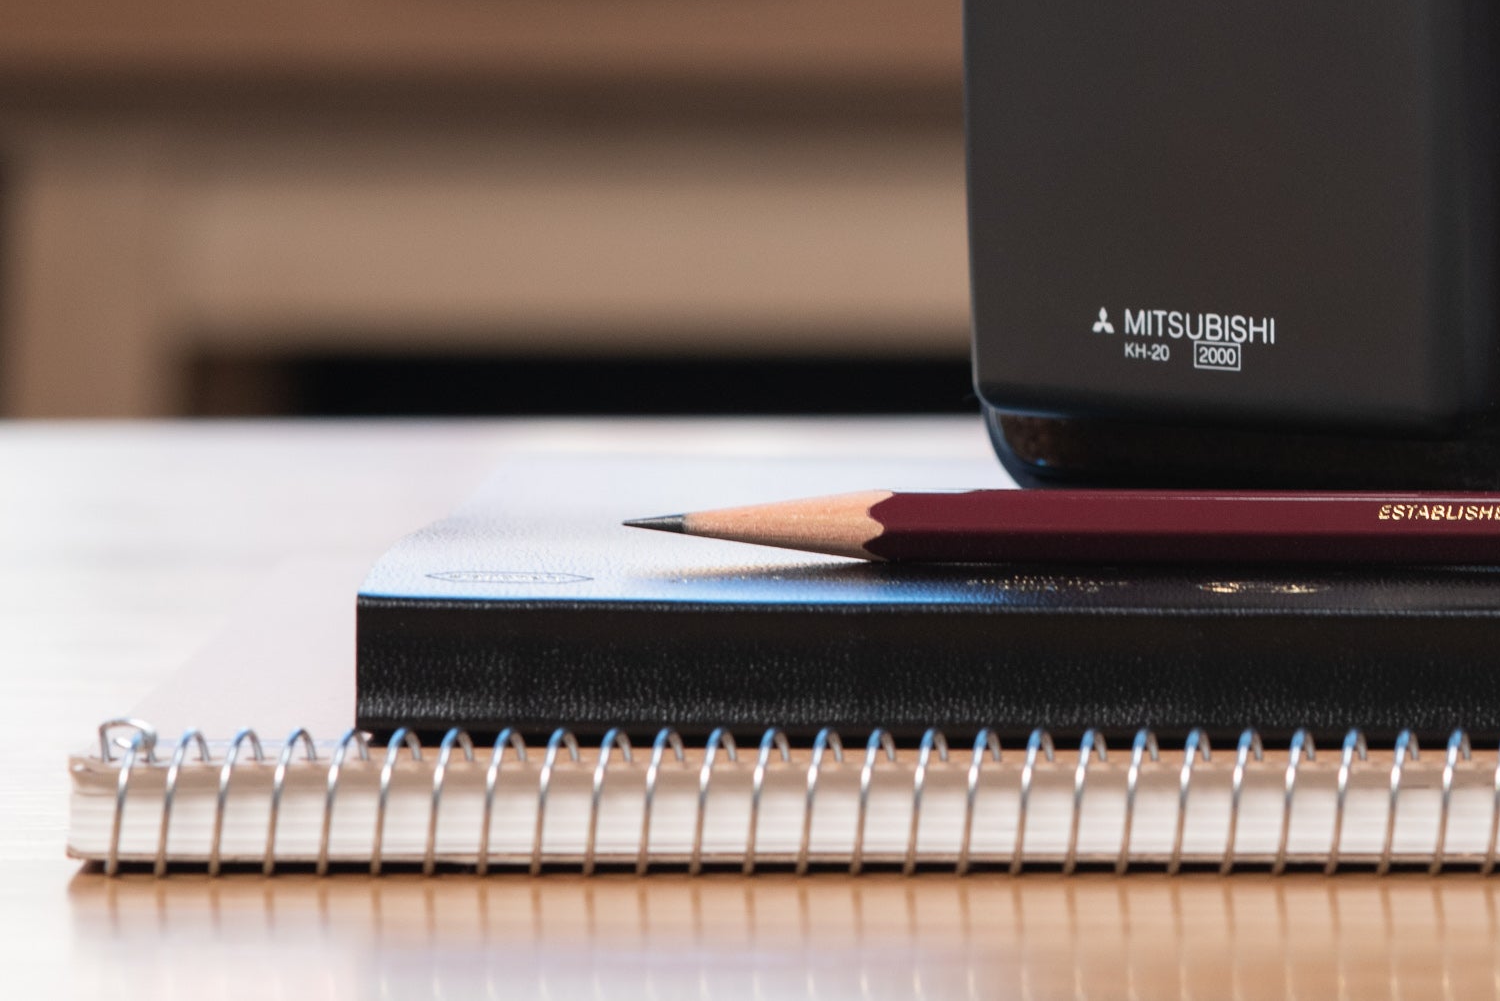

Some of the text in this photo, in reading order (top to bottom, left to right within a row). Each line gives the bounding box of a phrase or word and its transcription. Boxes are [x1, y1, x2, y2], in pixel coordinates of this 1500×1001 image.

[1124, 308, 1275, 345] MITSUBISHI
[1124, 342, 1236, 365] KH-20 2000
